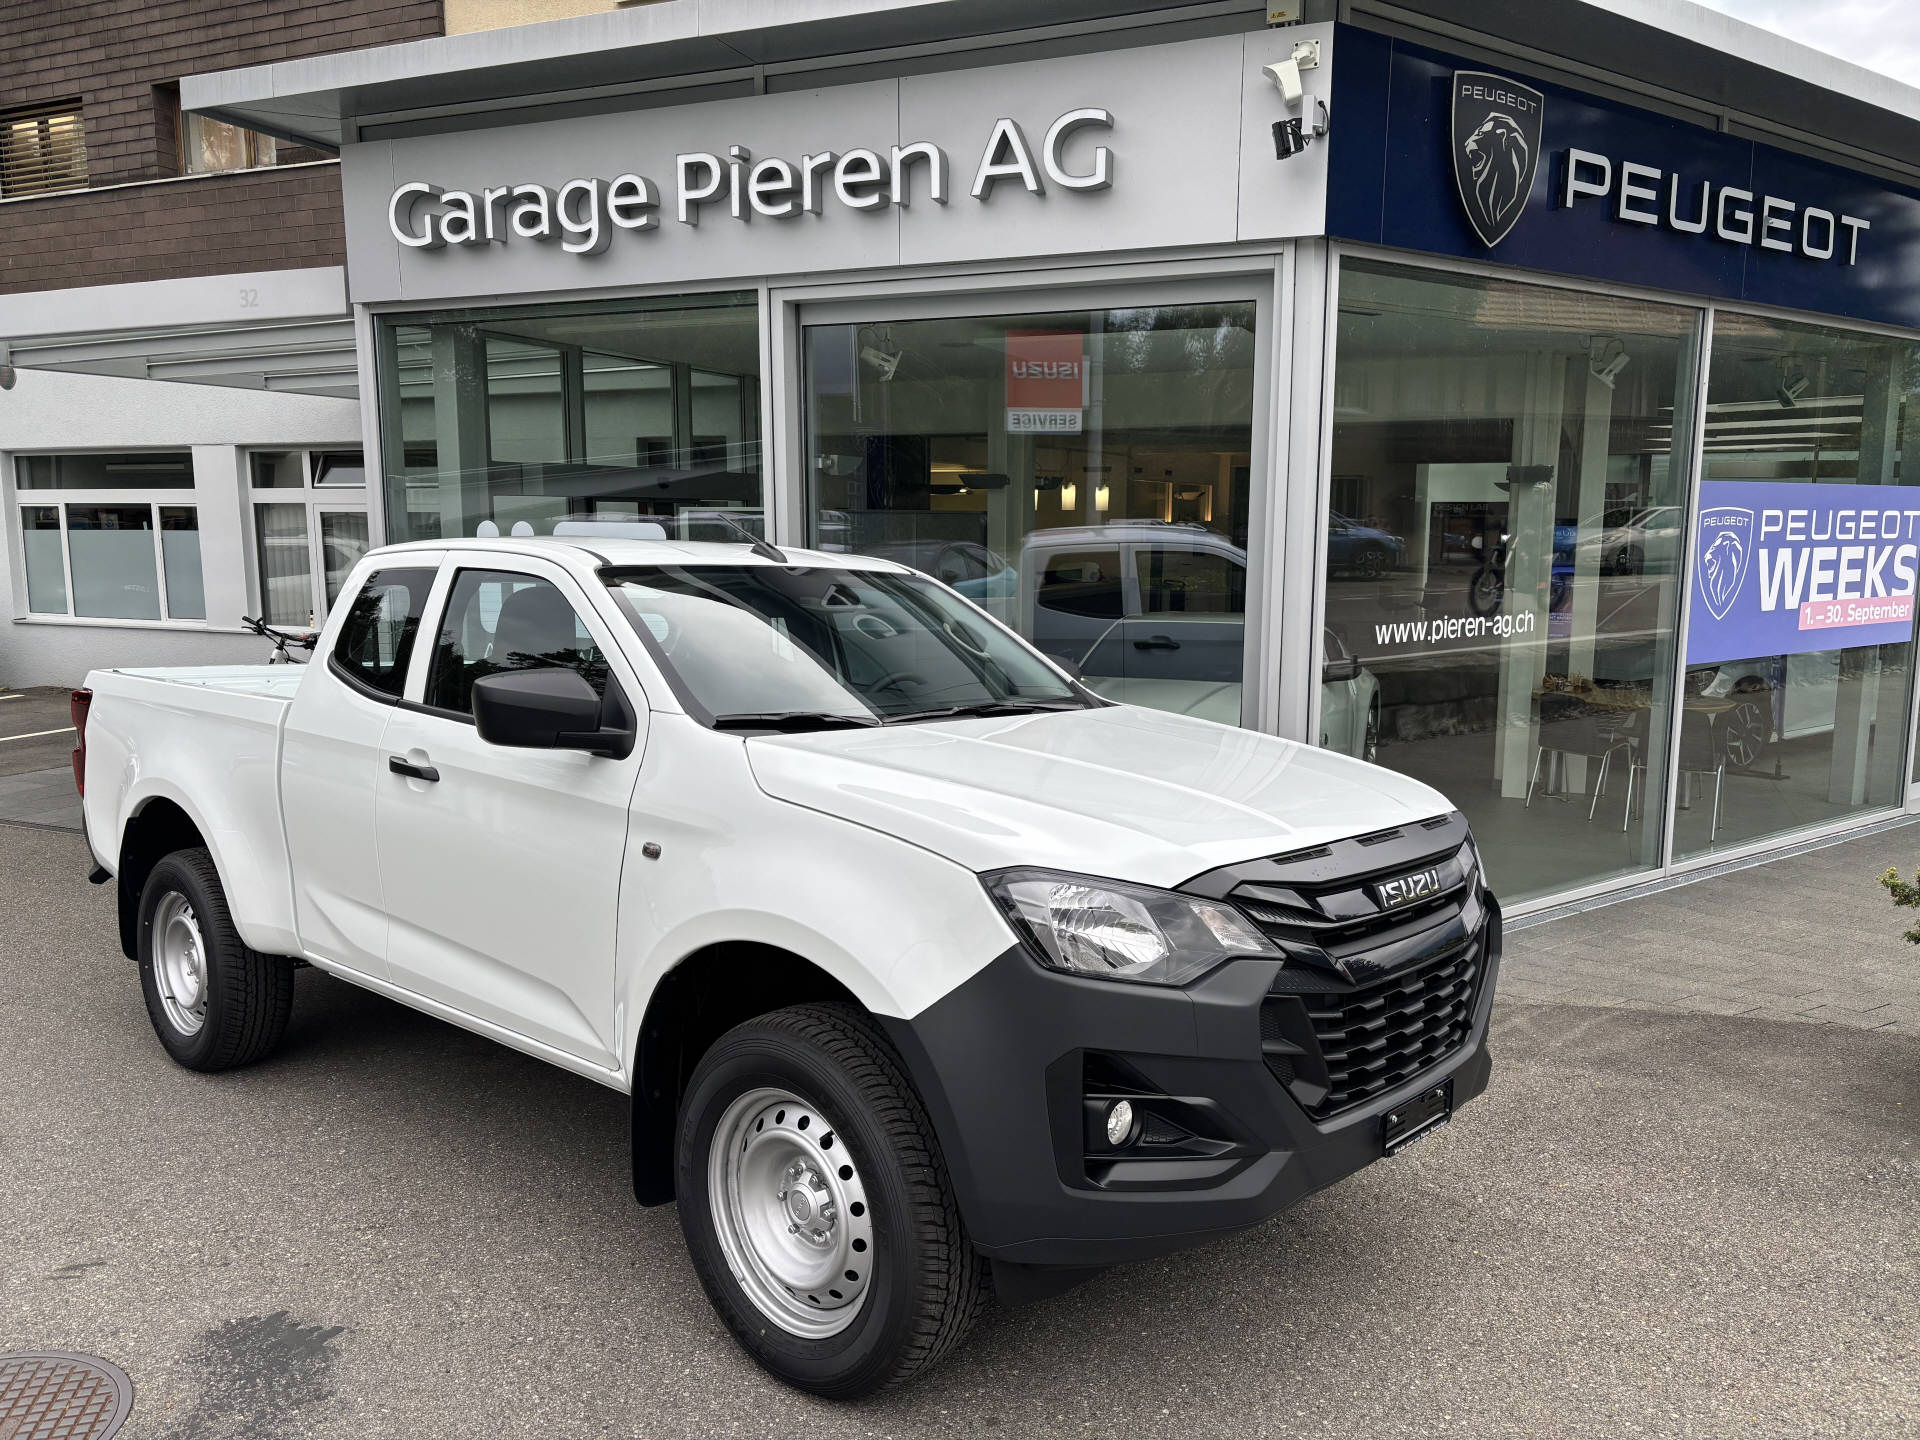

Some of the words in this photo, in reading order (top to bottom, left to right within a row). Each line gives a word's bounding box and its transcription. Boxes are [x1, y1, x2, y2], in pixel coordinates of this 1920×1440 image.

[1461, 85, 1537, 114] PEUGEOT
[388, 172, 656, 254] Garage
[676, 141, 947, 224] Pieren
[970, 107, 1114, 200] AG
[1565, 147, 1871, 266] PEUGEOT
[239, 288, 259, 308] 32
[1703, 516, 1750, 528] PEUGEOT
[1760, 509, 1920, 542] PEUGEOT
[1758, 544, 1918, 612] WEEKS
[1375, 610, 1535, 645] www.pieren-ag.ch
[1847, 601, 1910, 625] September
[1379, 869, 1440, 908] ISUZU
